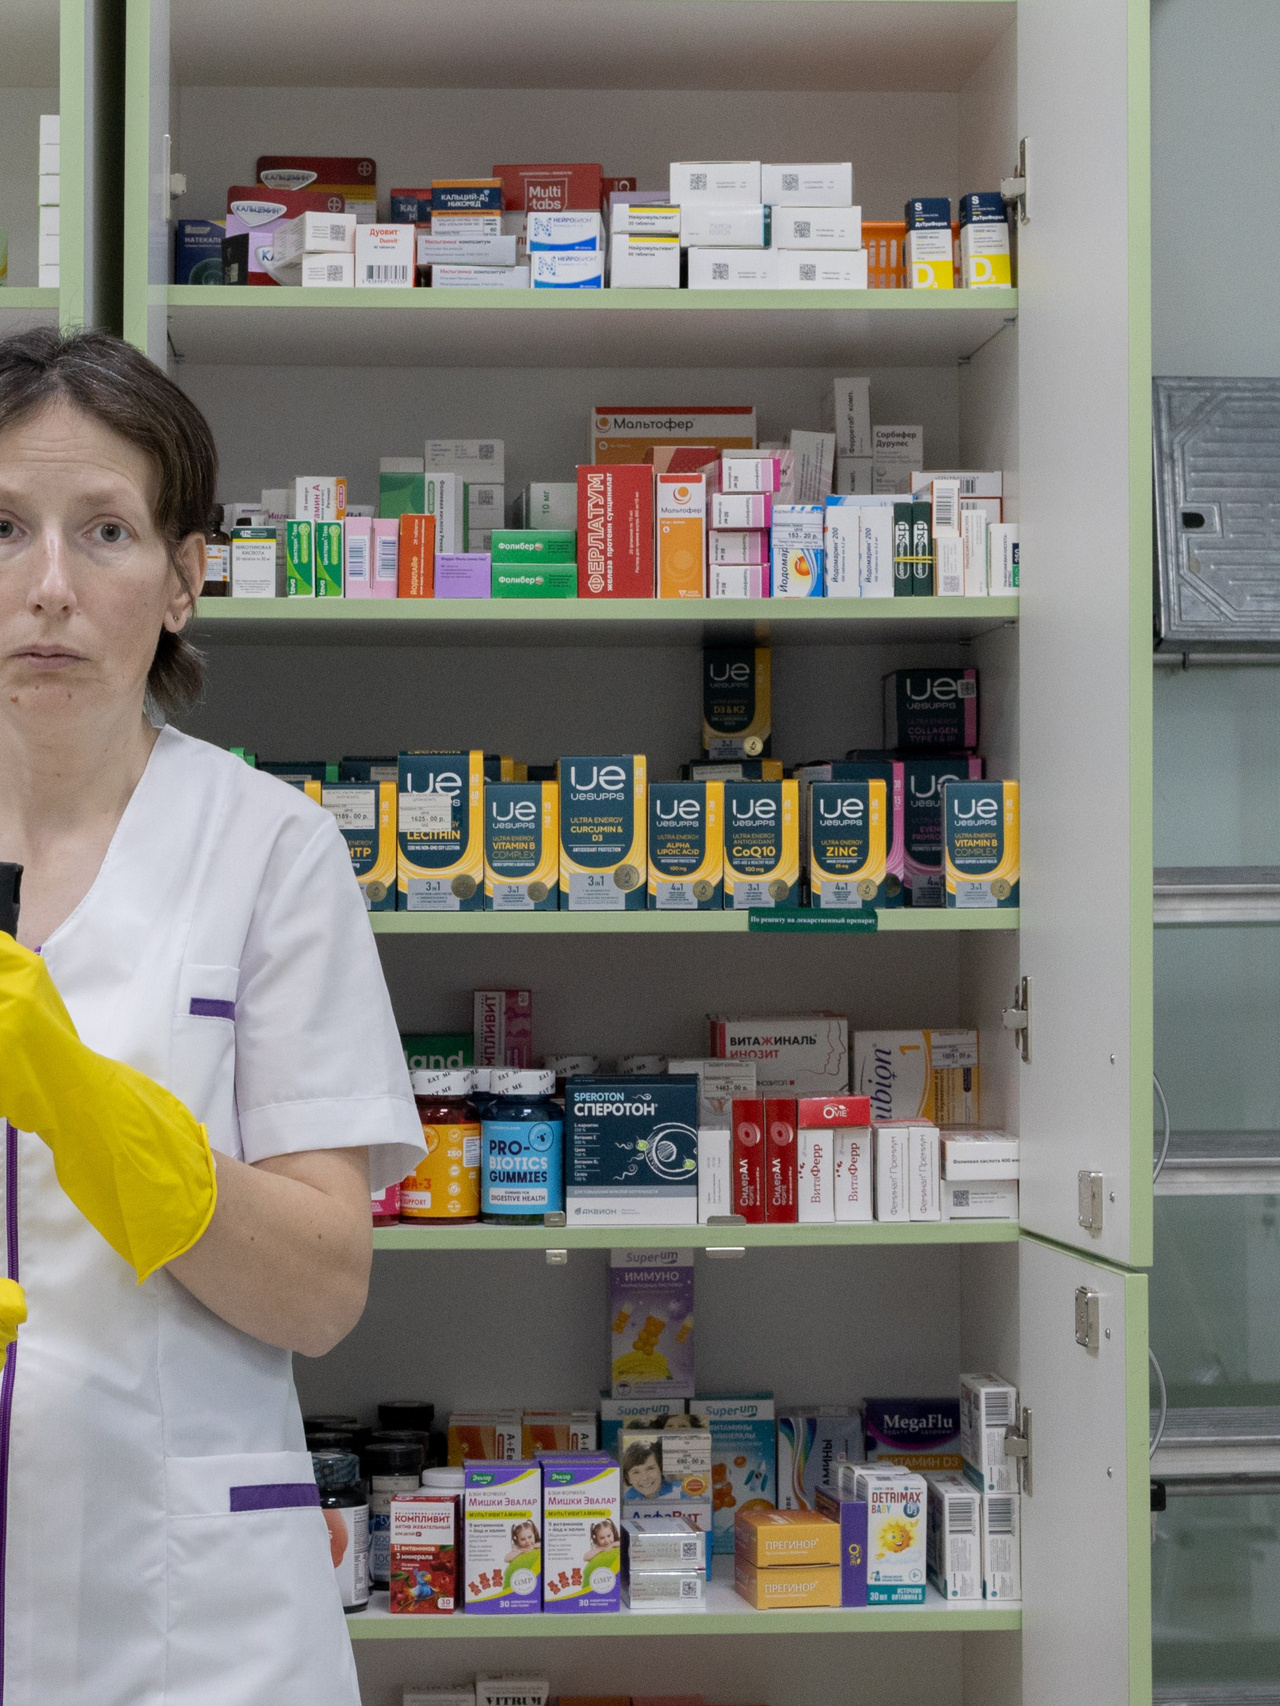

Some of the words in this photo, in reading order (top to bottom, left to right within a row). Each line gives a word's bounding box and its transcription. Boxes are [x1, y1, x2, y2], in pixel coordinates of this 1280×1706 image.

[529, 186, 561, 198] Multi
[369, 228, 398, 237] Дуовит
[613, 418, 693, 431] Мальтофер
[876, 431, 916, 439] Сорбифер
[876, 440, 909, 448] Дурулес
[588, 473, 605, 593] ФЕРЛАТУМ
[498, 542, 534, 550] Фолибер
[498, 576, 534, 584] Фолибер
[407, 830, 460, 840] LECITHIN
[492, 851, 535, 859] COMPLEX
[732, 847, 776, 858] CoQ10
[826, 847, 858, 857] ZINC
[955, 848, 997, 856] COMPLEX
[730, 1037, 816, 1046] ВИТАЖИНАЛЬ
[730, 1050, 779, 1059] ИНОЗИТ
[574, 1092, 624, 1101] SPEROTON
[574, 1103, 655, 1116] СПЕРОТОН
[490, 1140, 530, 1155] PRO-
[489, 1157, 548, 1170] BIOTICS
[489, 1171, 547, 1183] GUMMIES
[811, 1144, 822, 1204] ВитаФерр
[848, 1143, 860, 1202] ВитаФерр
[740, 1160, 748, 1206] СидерАЛ
[772, 1160, 781, 1206] СидерАЛ
[625, 1272, 679, 1281] ИММУНО
[883, 1414, 953, 1432] MegaFlu
[504, 1497, 537, 1506] ЭВАЛАР
[583, 1497, 616, 1505] ЭВАЛАР
[872, 1492, 921, 1504] DETRIMAX
[872, 1505, 891, 1514] BABY
[395, 1515, 450, 1523] КОМПЛИВИТ
[765, 1540, 816, 1550] ПРЕГИНОР
[514, 1577, 533, 1586] GMP
[593, 1576, 612, 1585] GMP
[764, 1582, 815, 1593] ПРЕГИНОР
